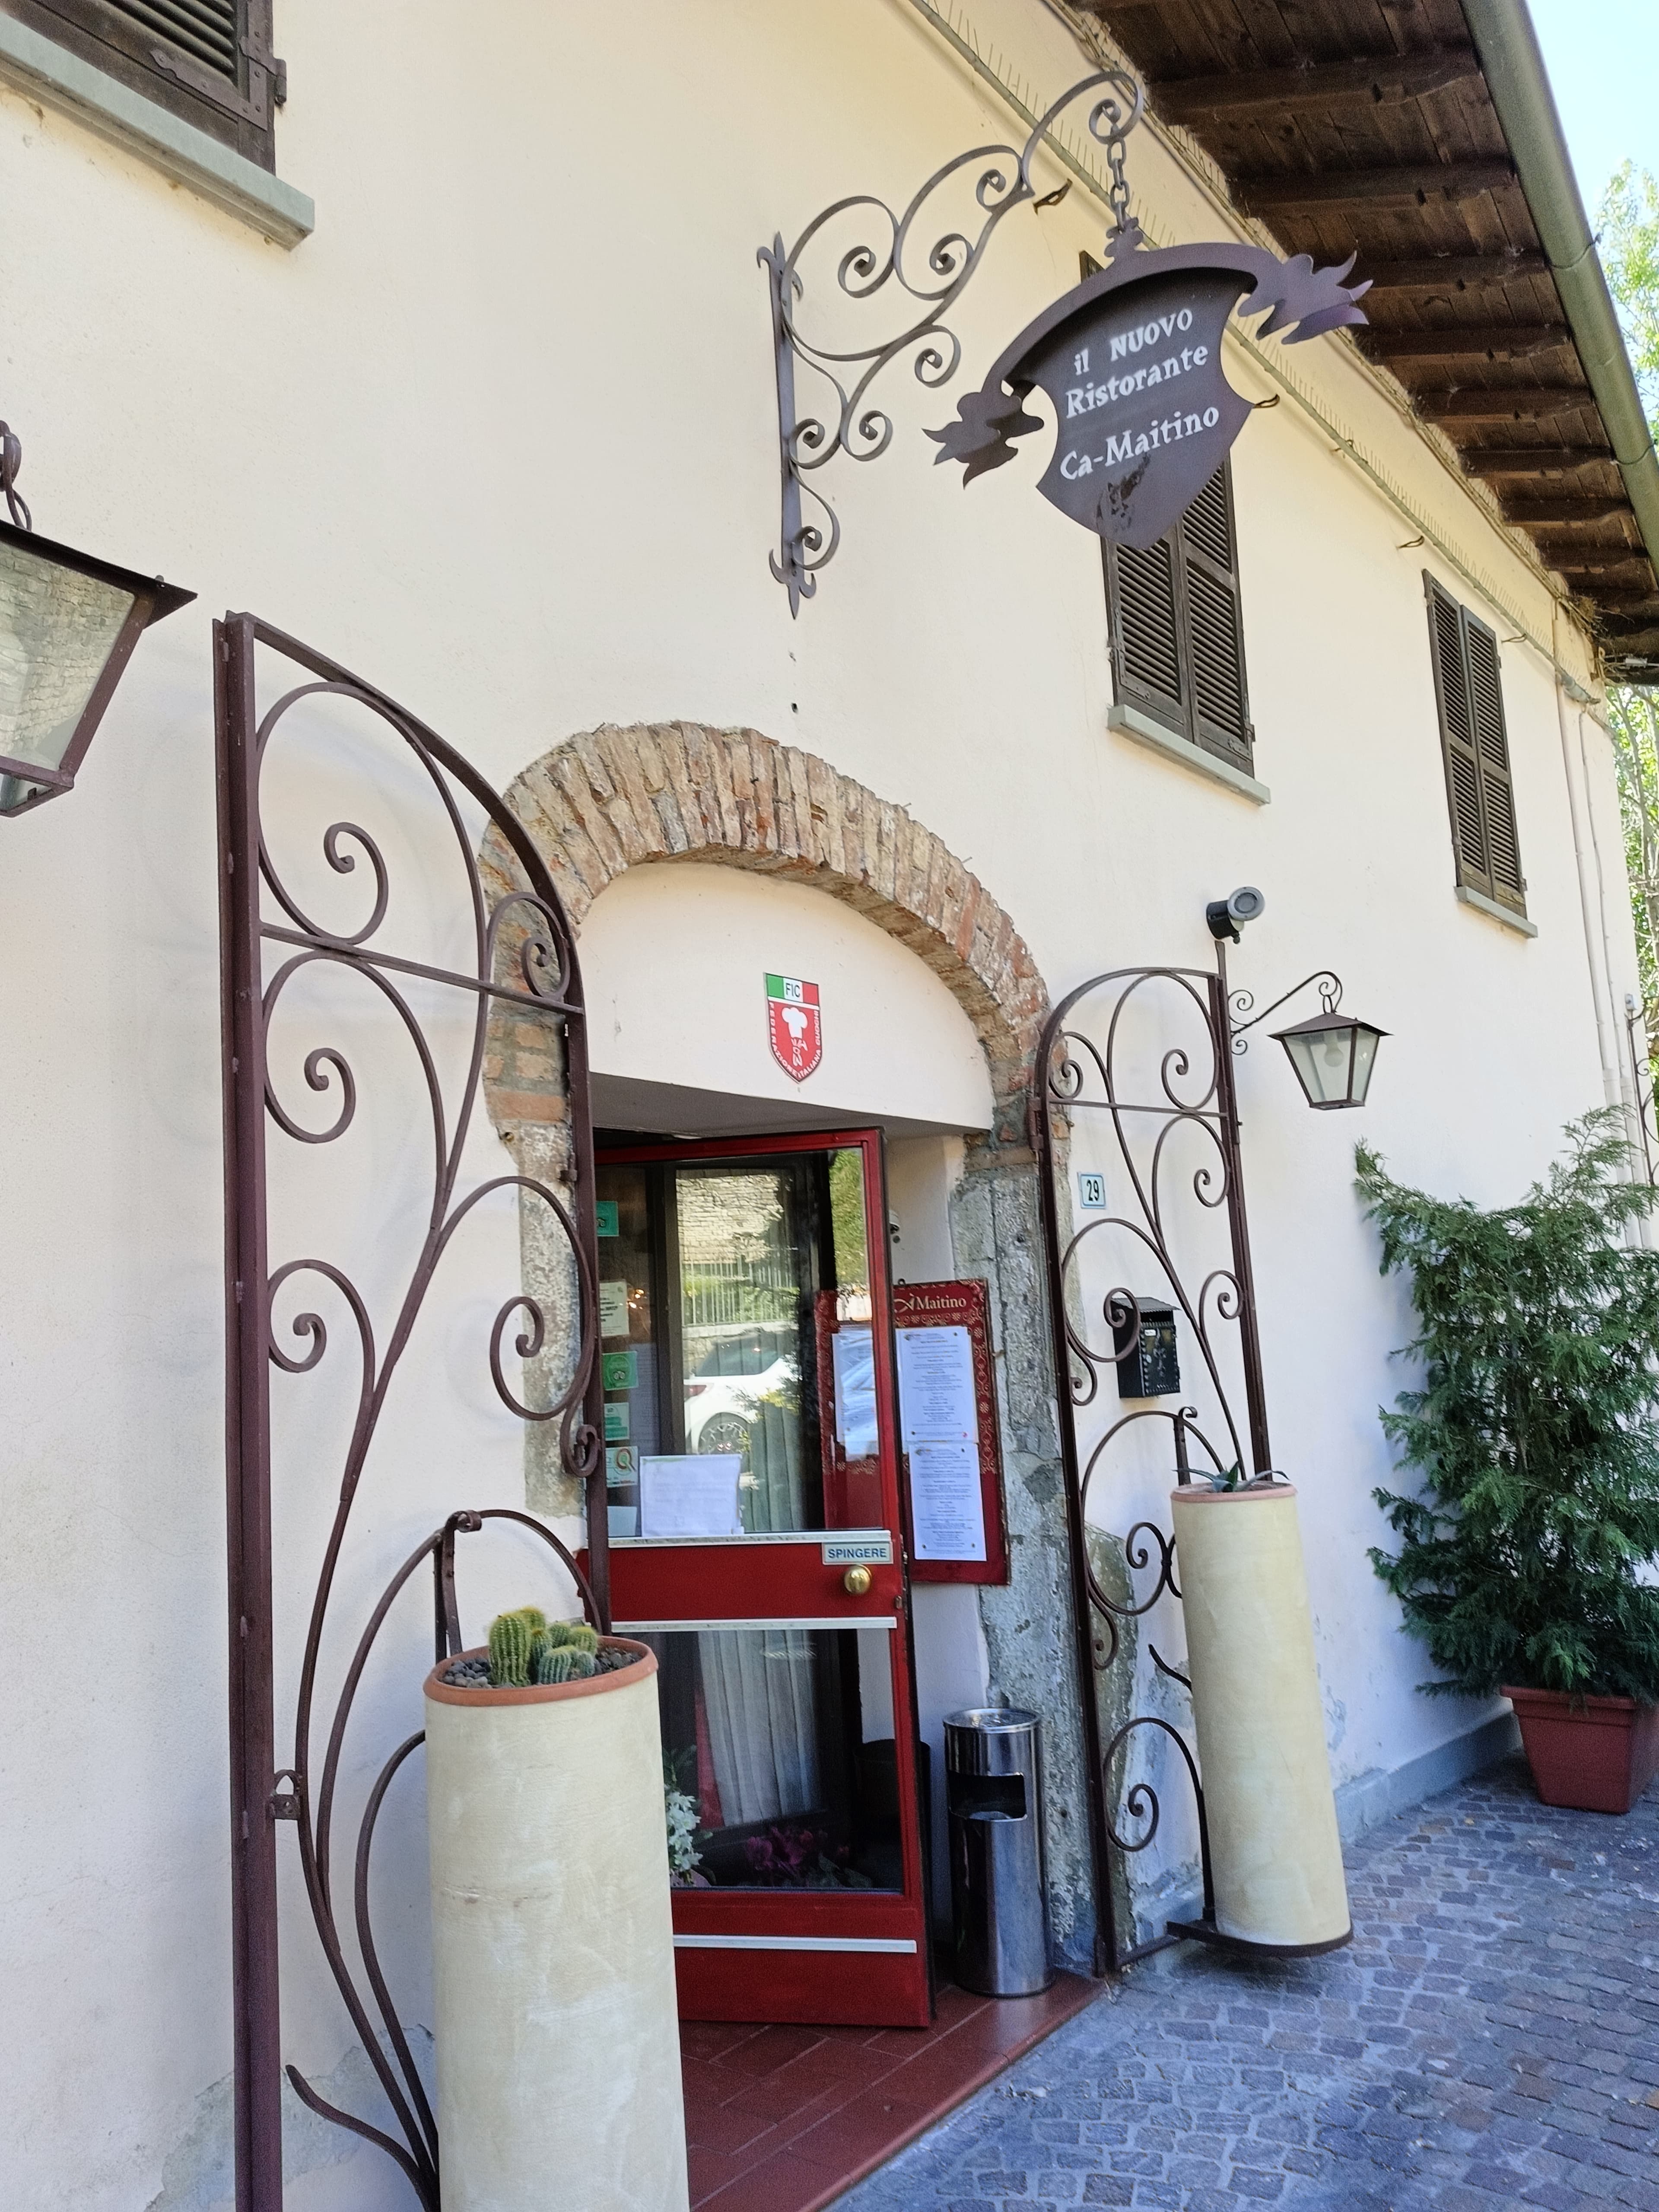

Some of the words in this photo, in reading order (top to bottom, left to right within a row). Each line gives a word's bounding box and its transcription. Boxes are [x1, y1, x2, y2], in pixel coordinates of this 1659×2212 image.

[1073, 348, 1090, 376] il
[1109, 308, 1194, 362] NUOVO
[1065, 344, 1208, 419] Ristorante
[1059, 405, 1220, 481] Ca-Maitino
[785, 982, 801, 998] FIC
[769, 1002, 798, 1077] FEDERAZIONE
[798, 1049, 821, 1079] ITALIANA
[1087, 1179, 1100, 1201] 29
[916, 1295, 967, 1310] Maitino
[828, 1548, 887, 1558] SPINGERE
